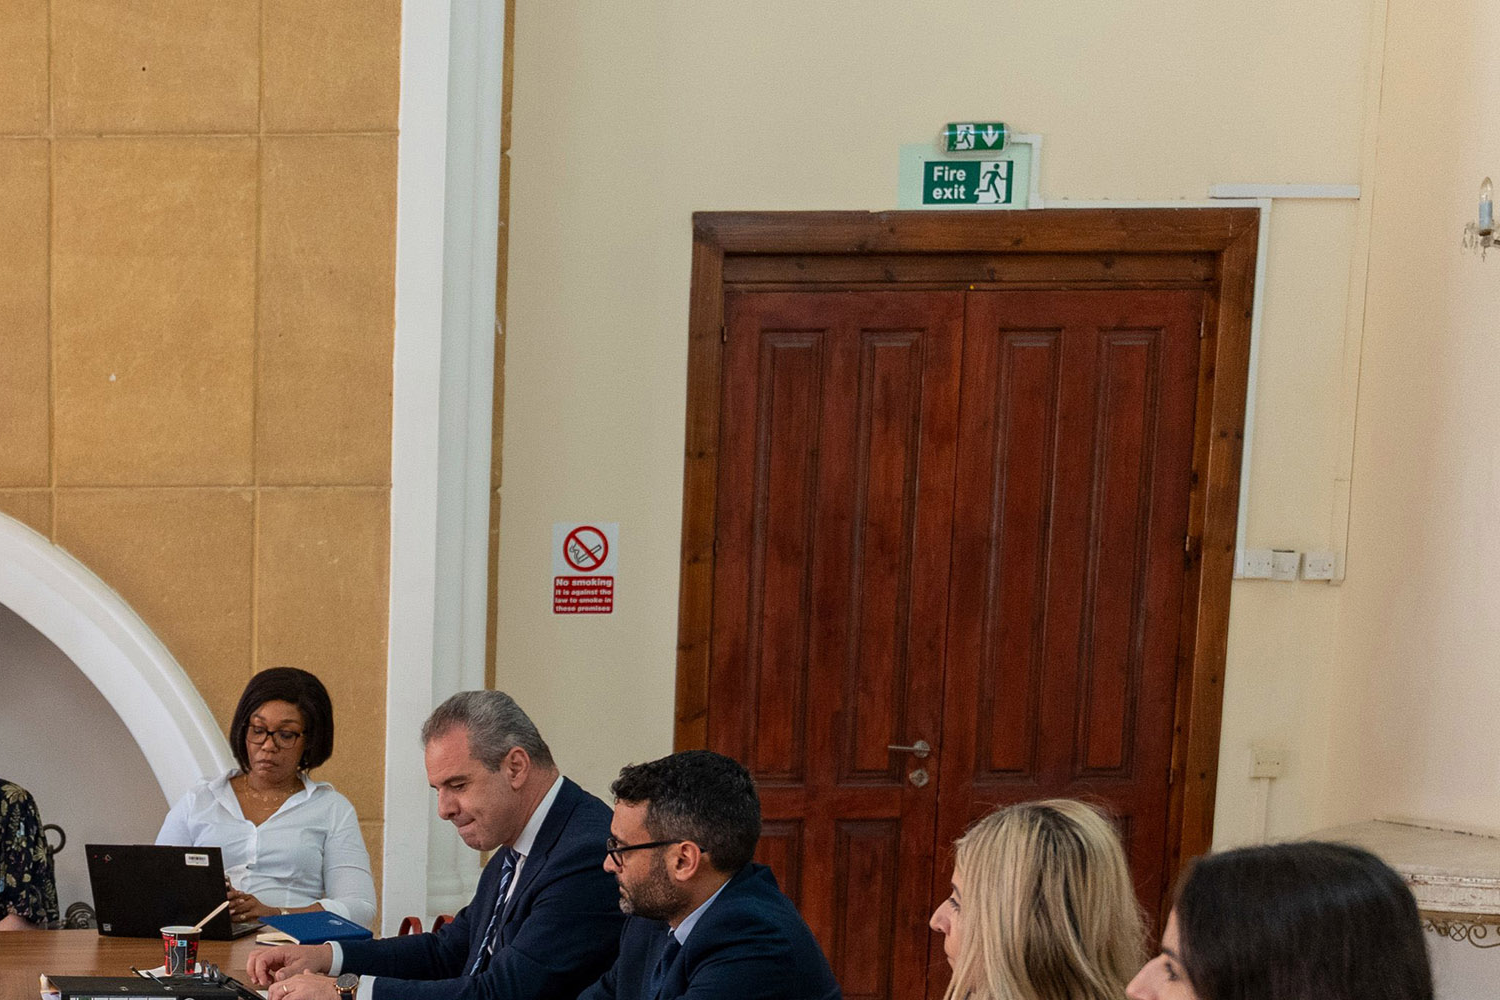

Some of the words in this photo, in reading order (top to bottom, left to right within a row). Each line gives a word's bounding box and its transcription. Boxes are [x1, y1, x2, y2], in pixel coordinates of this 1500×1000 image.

[933, 165, 966, 181] Fire
[932, 184, 966, 199] exit
[555, 578, 569, 586] No
[572, 578, 612, 588] smoking
[571, 589, 598, 597] against
[577, 605, 611, 613] premises
